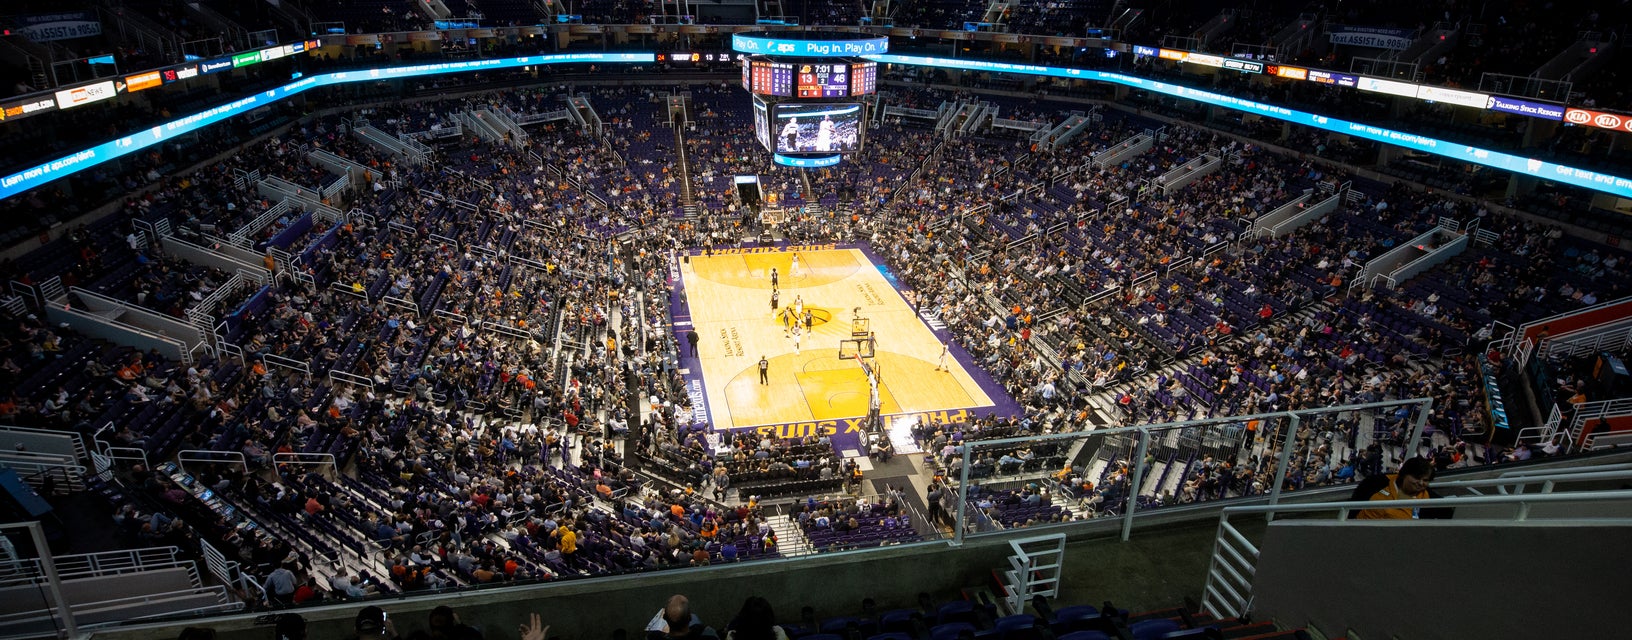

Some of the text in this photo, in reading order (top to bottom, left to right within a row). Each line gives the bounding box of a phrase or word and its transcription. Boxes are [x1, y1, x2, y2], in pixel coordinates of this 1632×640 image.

[41, 26, 68, 38] ASSIST
[68, 26, 76, 36] to
[734, 38, 759, 49] Play On.
[1348, 36, 1376, 46] ASSIST
[1377, 38, 1384, 46] to
[778, 44, 795, 52] aps
[807, 44, 829, 54] Plug
[832, 44, 842, 53] In.
[845, 43, 863, 54] Play
[864, 43, 876, 52] On.
[815, 65, 830, 73] 7:01
[802, 74, 812, 83] 13
[1570, 112, 1587, 122] KIA
[1598, 116, 1616, 126] KIA
[1350, 122, 1365, 132] Learn
[1366, 127, 1382, 136] more
[1474, 150, 1488, 159] aps
[2, 150, 95, 188] Learn more at aps.com/alerts
[1556, 165, 1572, 176] Get
[1574, 169, 1592, 180] text
[1595, 173, 1614, 185] and
[700, 243, 836, 256] PHOENIX SUNS
[757, 418, 836, 440] SUNS
